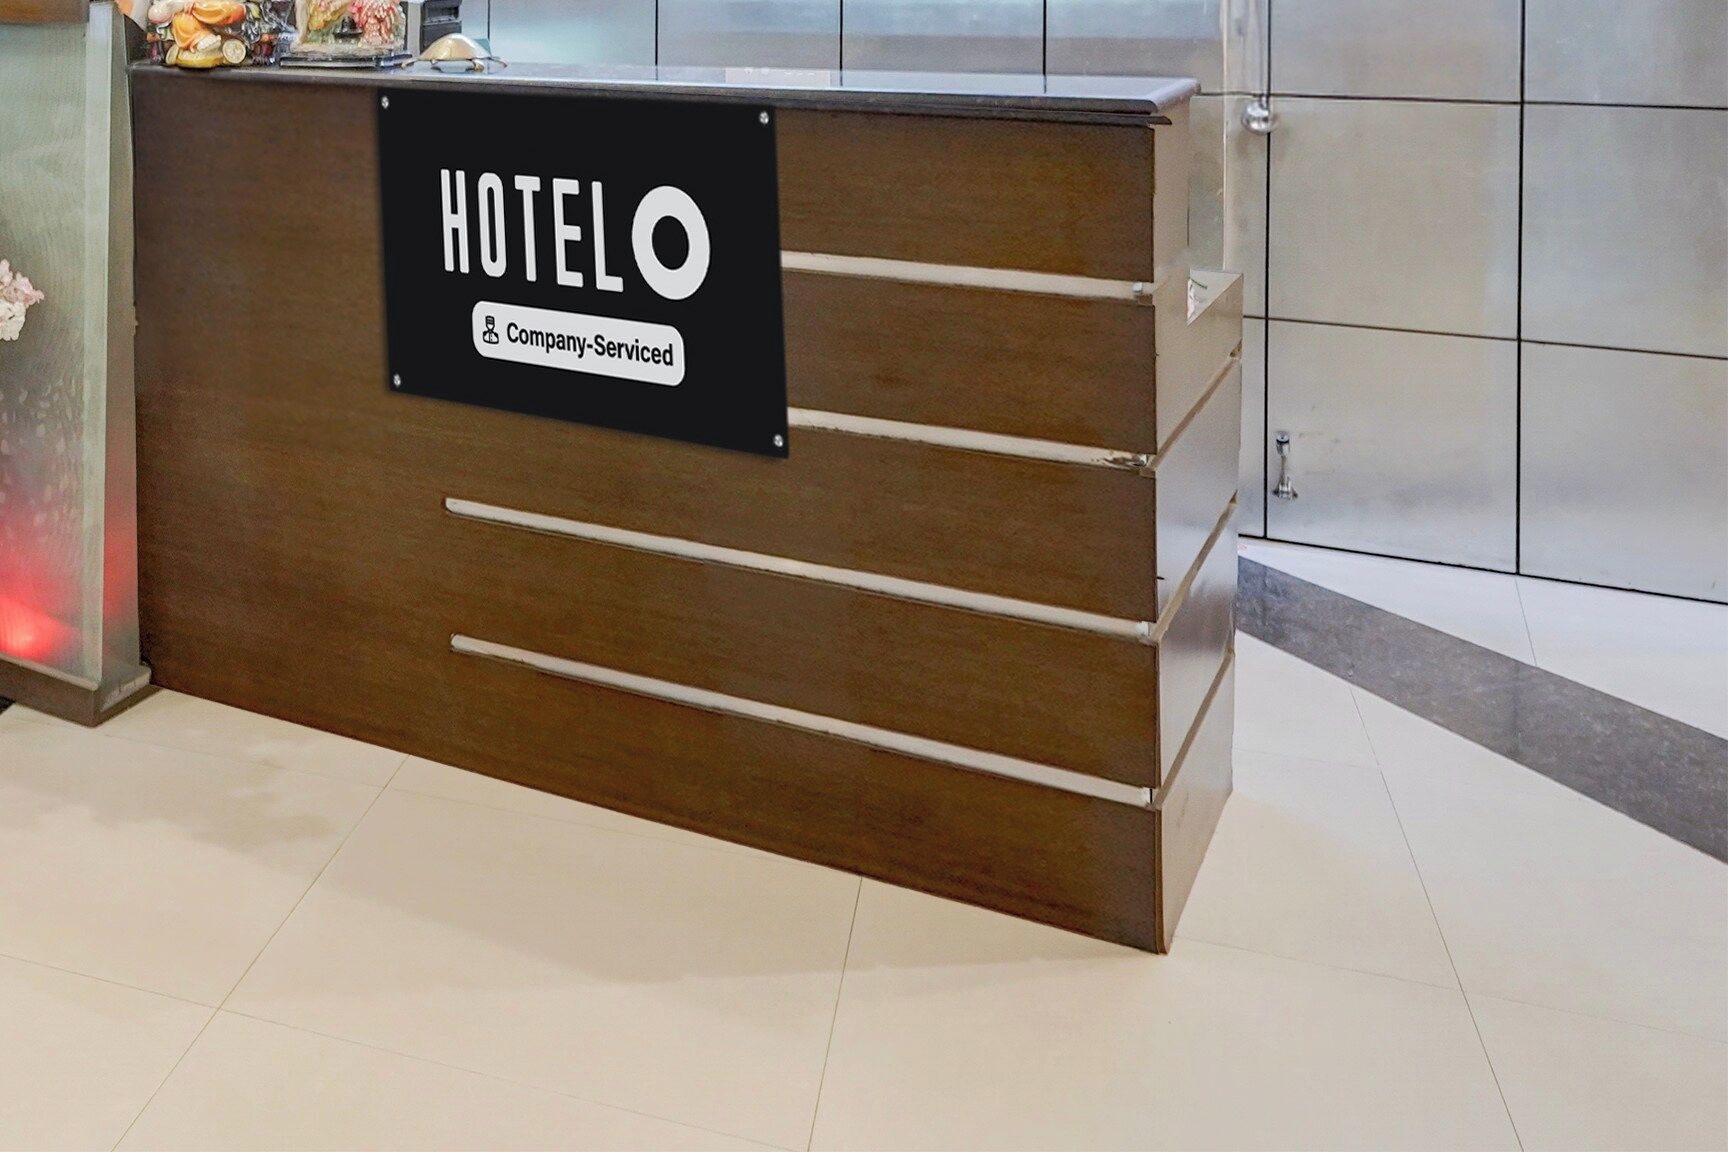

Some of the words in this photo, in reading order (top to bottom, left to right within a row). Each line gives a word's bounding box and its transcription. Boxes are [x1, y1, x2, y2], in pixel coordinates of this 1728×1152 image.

[440, 168, 624, 292] HOTEL
[631, 185, 711, 300] O
[506, 322, 674, 366] Company-Serviced
